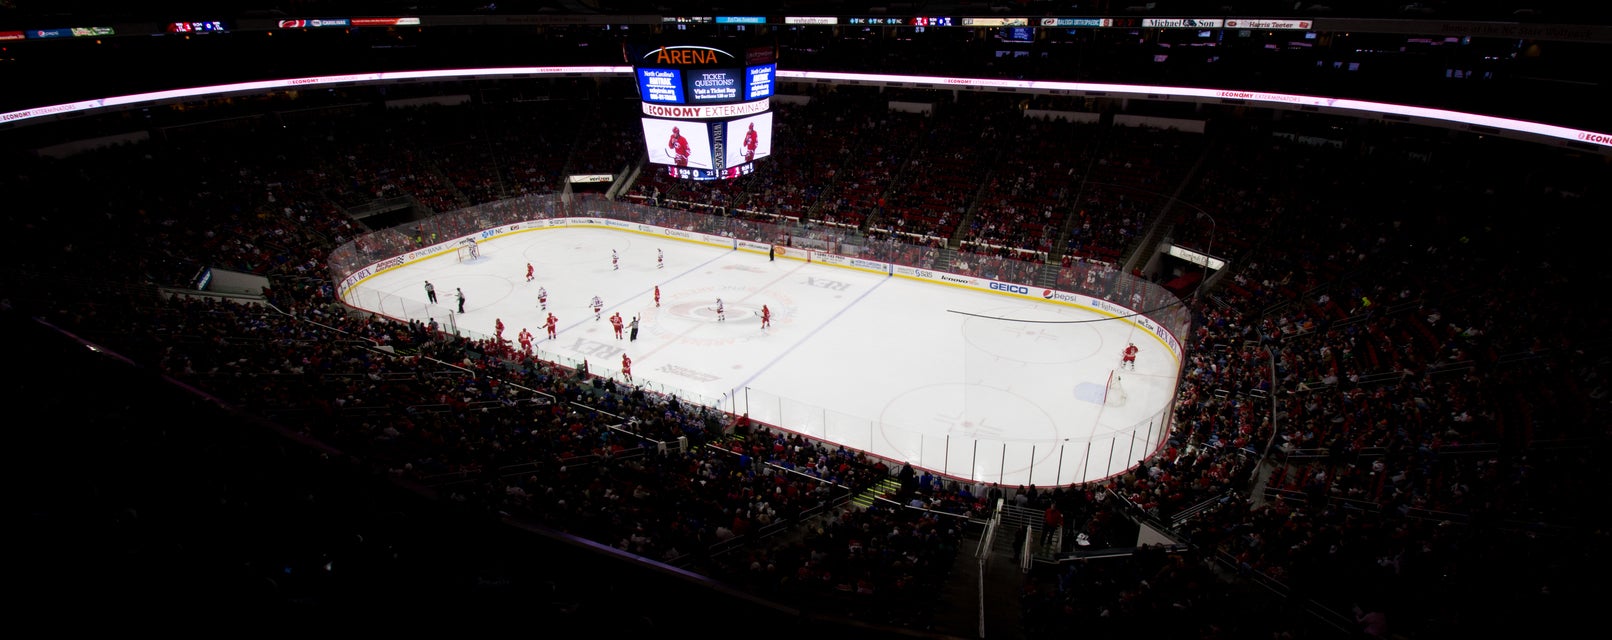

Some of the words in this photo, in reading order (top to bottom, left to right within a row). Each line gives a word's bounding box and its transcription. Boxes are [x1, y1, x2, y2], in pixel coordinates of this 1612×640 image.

[657, 46, 718, 64] ARENA
[694, 79, 734, 87] QUESTIONS?
[3, 111, 31, 121] ECONOMY
[32, 104, 76, 116] EXTERMINATORS
[649, 106, 701, 116] ECONOMY
[713, 124, 722, 143] WRAL
[715, 144, 723, 168] NEWS
[346, 275, 358, 287] REX
[358, 269, 371, 280] REX
[941, 275, 968, 284] lenovo
[990, 282, 1028, 294] GEICO
[1054, 292, 1076, 301] pepsi
[1156, 326, 1168, 342] REX
